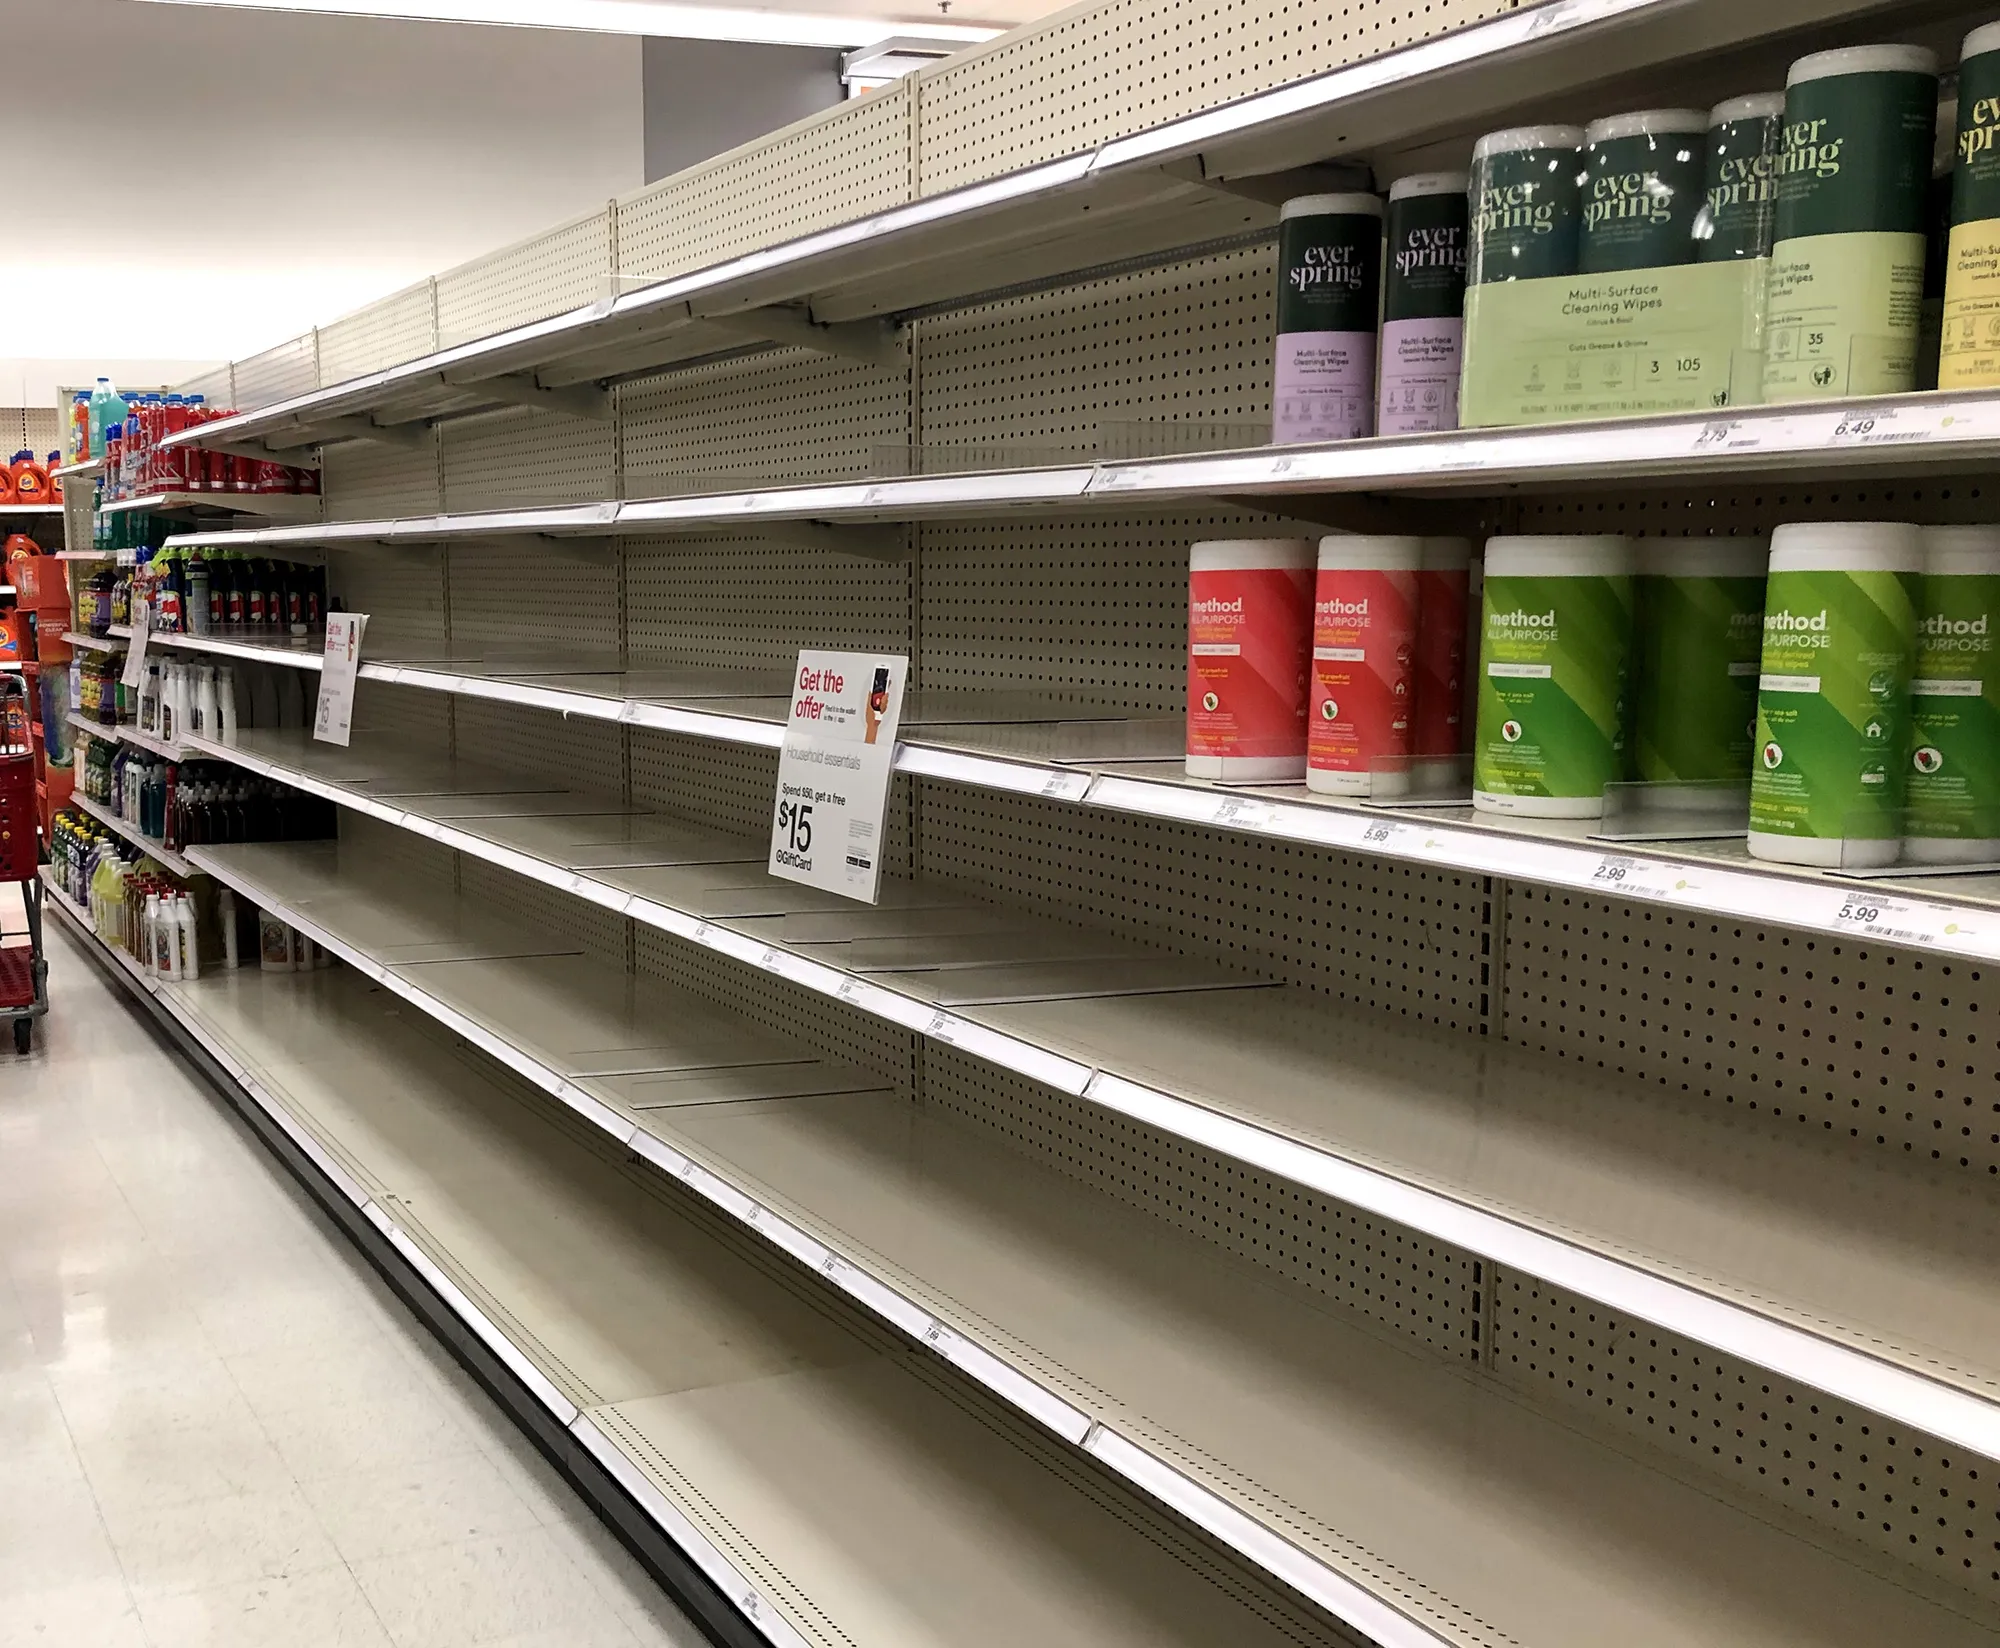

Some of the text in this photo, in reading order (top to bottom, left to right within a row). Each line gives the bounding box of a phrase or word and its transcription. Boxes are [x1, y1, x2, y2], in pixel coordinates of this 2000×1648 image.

[1972, 96, 2000, 125] ev
[1782, 118, 1827, 147] ver
[1480, 182, 1540, 211] ever
[1594, 171, 1660, 201] ever
[1471, 198, 1555, 235] spring
[1583, 189, 1672, 232] spring
[1408, 227, 1460, 248] ever
[1304, 246, 1354, 265] ever
[1395, 241, 1467, 277] spring
[1957, 259, 1998, 272] Cleaning
[1289, 261, 1363, 292] spring
[1568, 283, 1659, 301] Multi-Surface
[1561, 297, 1663, 316] Cleaning Wipes
[1808, 332, 1824, 346] 35
[1651, 357, 1701, 374] 3 105
[1835, 420, 1875, 436] 6.49
[1192, 597, 1242, 614] method
[1489, 609, 1555, 628] method
[800, 666, 844, 694] Get the
[795, 695, 824, 720] offer
[786, 743, 861, 771] Household essentials
[781, 782, 846, 806] Spend $50, get a free
[1216, 804, 1239, 817] 2.99
[778, 798, 813, 853] $15
[1363, 828, 1389, 842] 5.99
[782, 850, 812, 872] GiftCard
[1594, 865, 1626, 881] 2.99
[1838, 904, 1879, 923] 5.99
